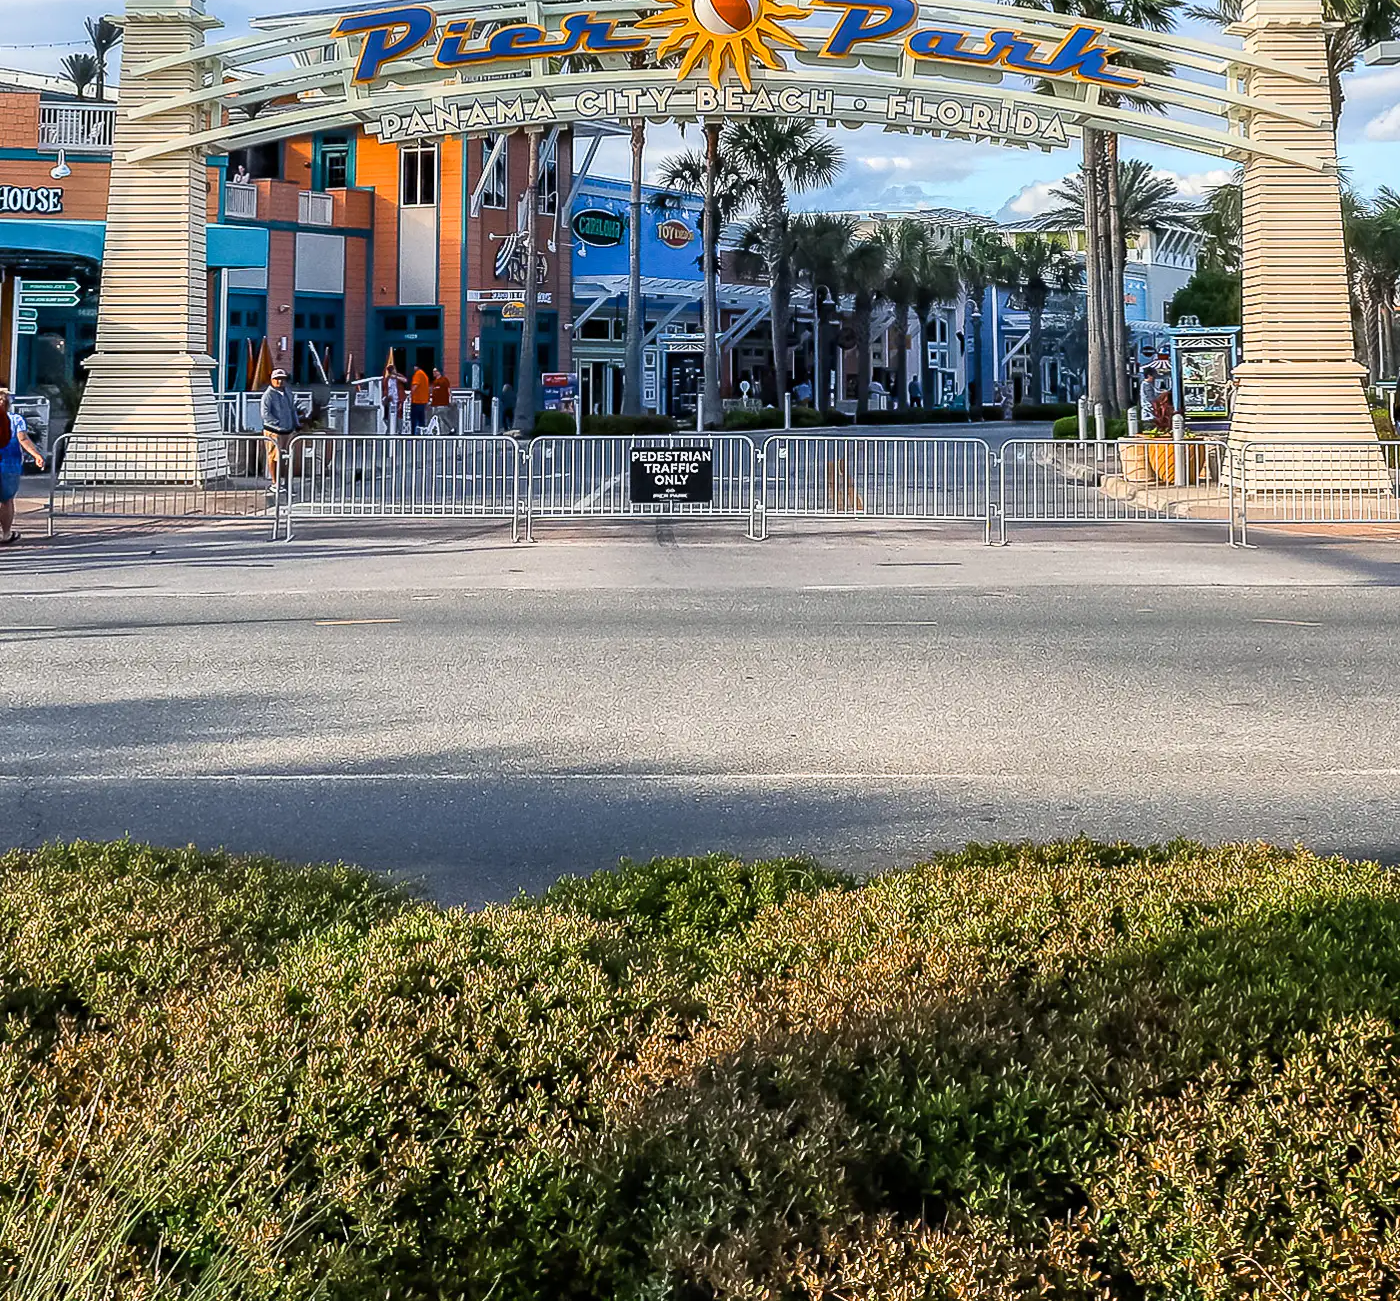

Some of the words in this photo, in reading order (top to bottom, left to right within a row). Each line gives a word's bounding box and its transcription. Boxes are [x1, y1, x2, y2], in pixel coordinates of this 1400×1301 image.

[330, 4, 651, 86] Pier
[379, 93, 557, 139] PANAMA
[575, 86, 674, 117] CITY
[695, 85, 834, 114] BEACH
[886, 94, 1068, 143] FLORIDA
[0, 186, 62, 212] HOUSE
[631, 451, 711, 462] PEDESTRIAN
[643, 463, 699, 474] TRAFFIC
[654, 474, 689, 486] ONLY
